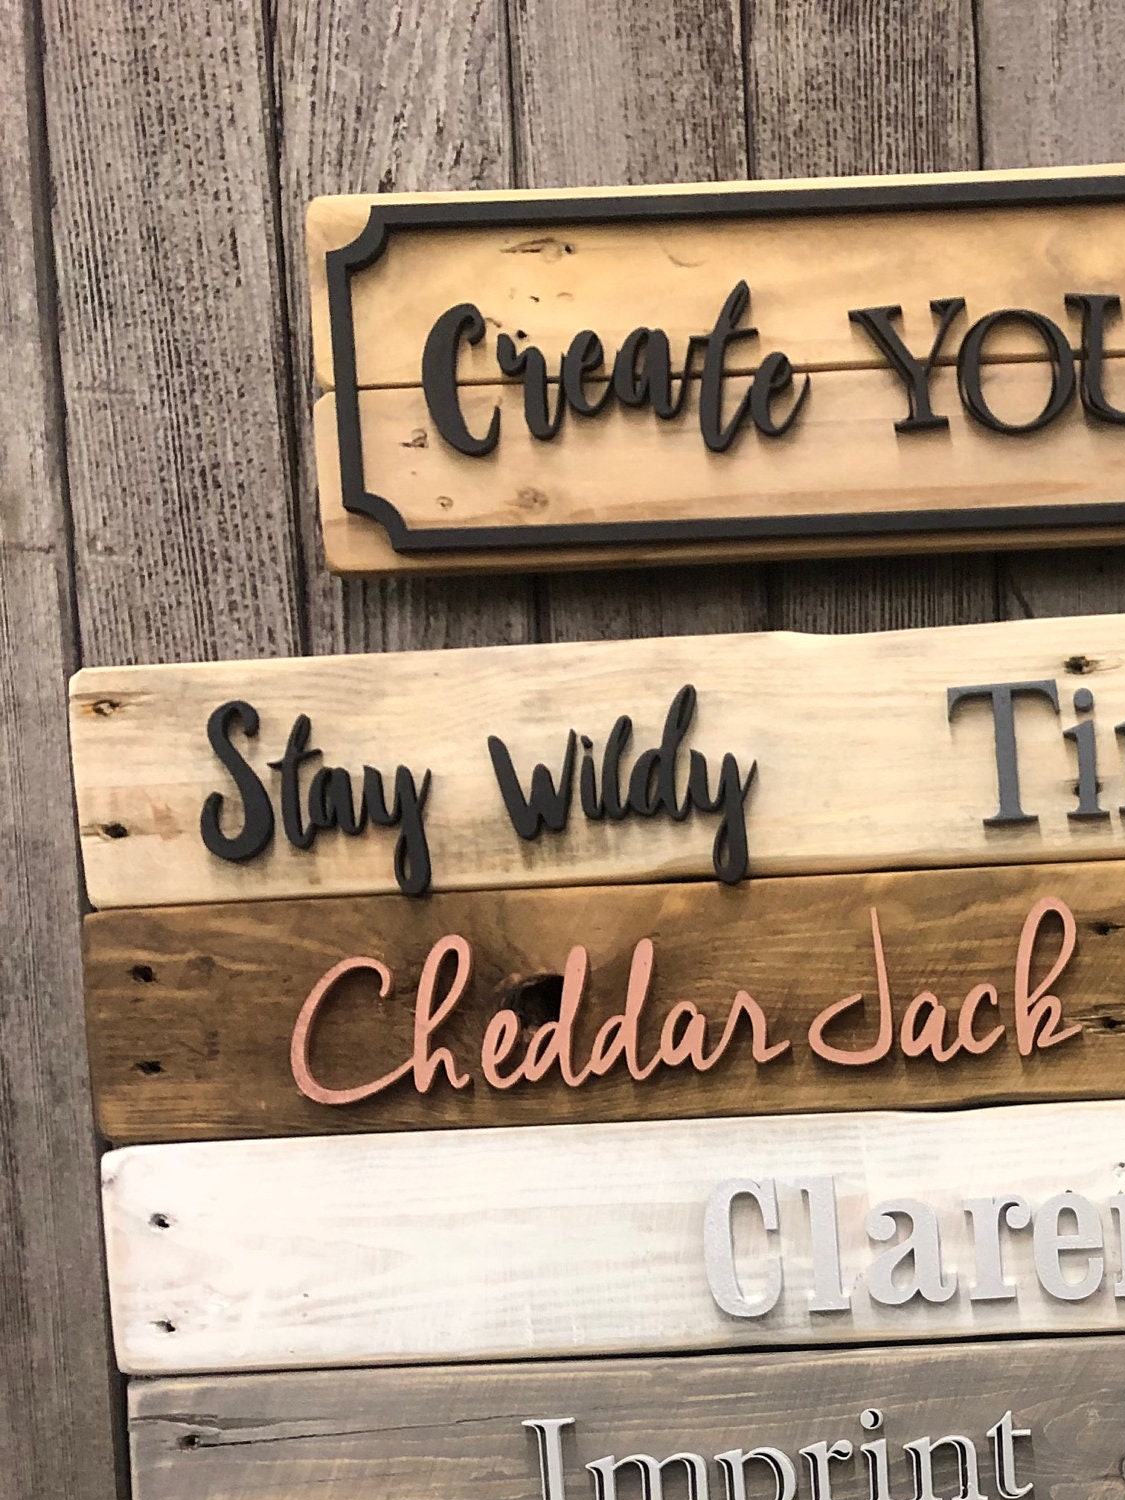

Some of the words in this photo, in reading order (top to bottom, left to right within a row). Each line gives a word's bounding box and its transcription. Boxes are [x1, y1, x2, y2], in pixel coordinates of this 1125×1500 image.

[422, 279, 811, 457] Create
[200, 699, 431, 896] Stay
[290, 934, 789, 1106] Cheddar
[809, 896, 1082, 1067] Jack
